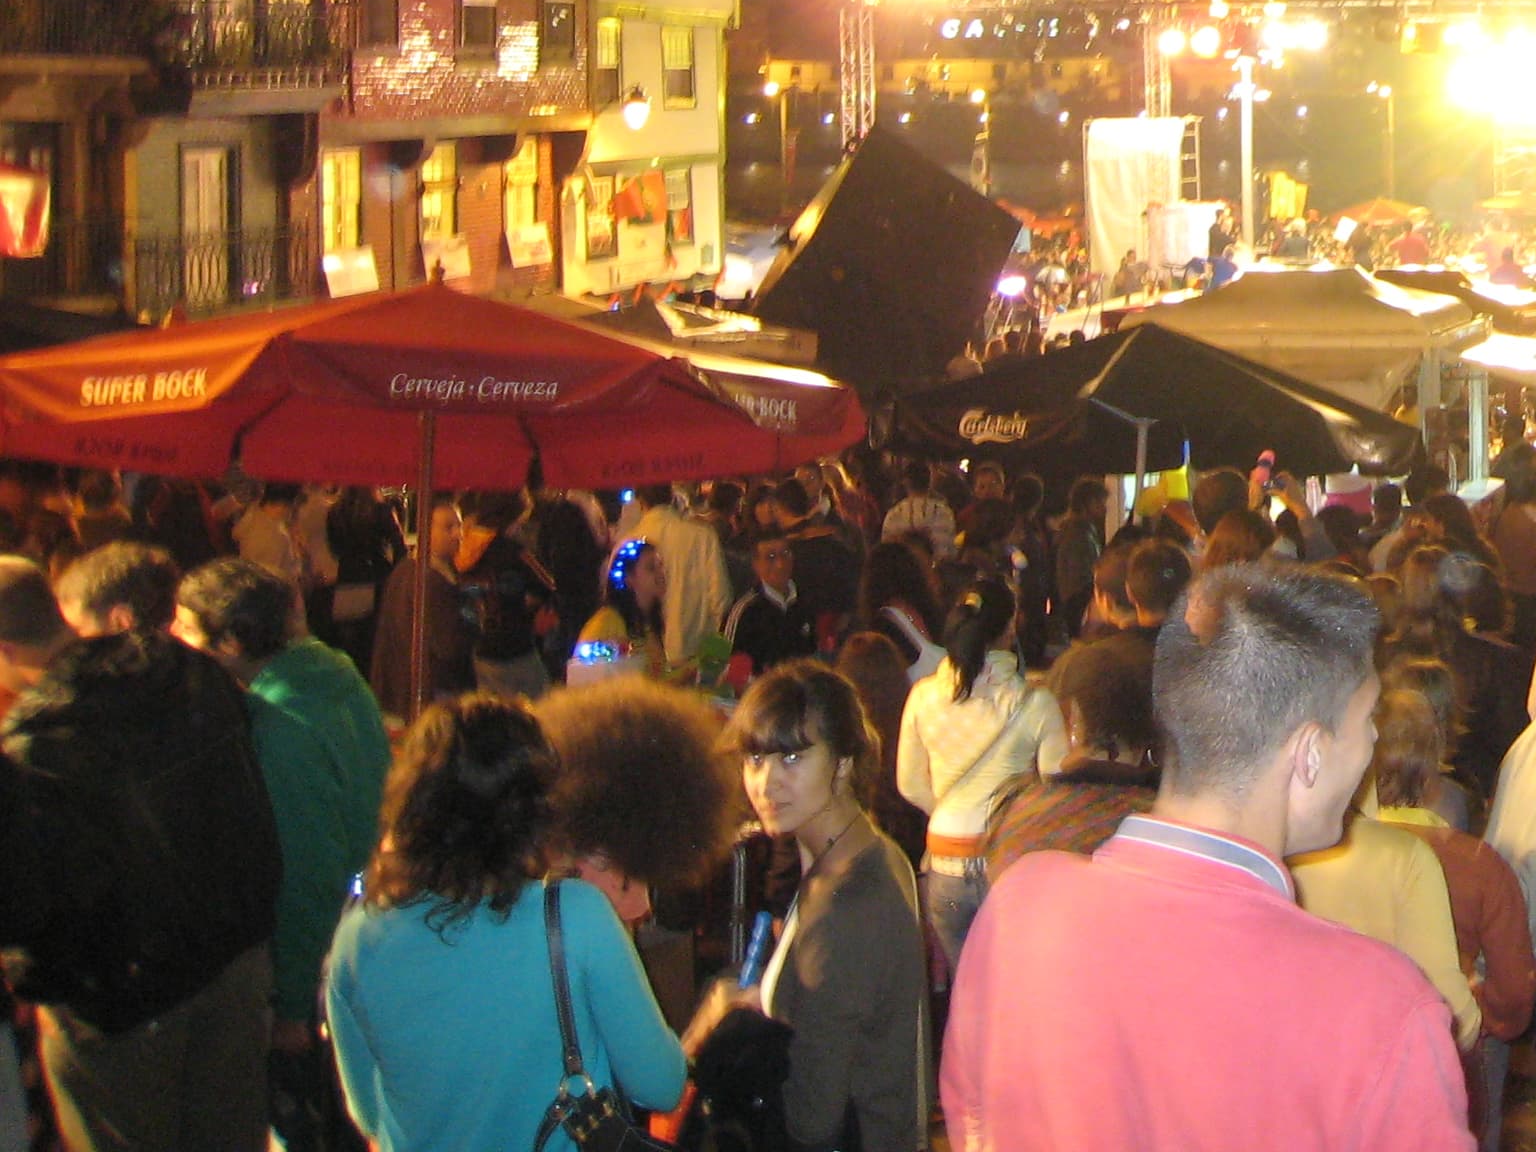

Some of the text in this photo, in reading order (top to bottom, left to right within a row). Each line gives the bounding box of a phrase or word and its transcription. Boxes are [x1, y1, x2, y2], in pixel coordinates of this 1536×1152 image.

[80, 367, 208, 407] SUPER BOCK
[390, 373, 558, 401] Cerveja Cerveza
[759, 396, 797, 424] BOCK
